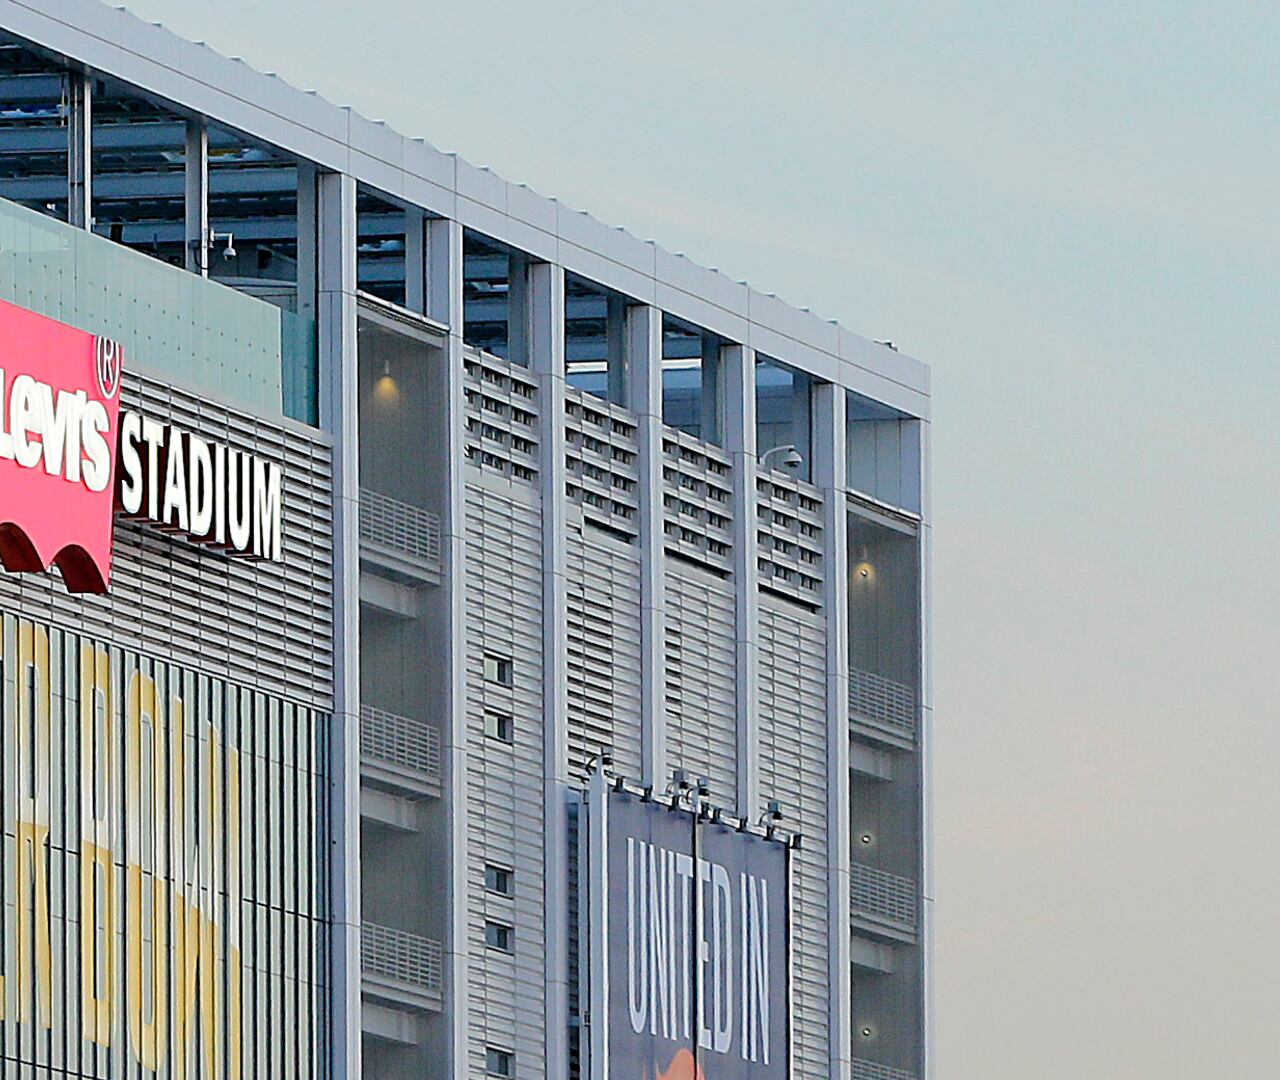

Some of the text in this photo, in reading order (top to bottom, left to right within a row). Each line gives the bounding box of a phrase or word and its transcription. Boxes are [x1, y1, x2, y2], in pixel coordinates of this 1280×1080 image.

[121, 410, 283, 563] STADIUM
[627, 836, 770, 1066] UNITED IN
